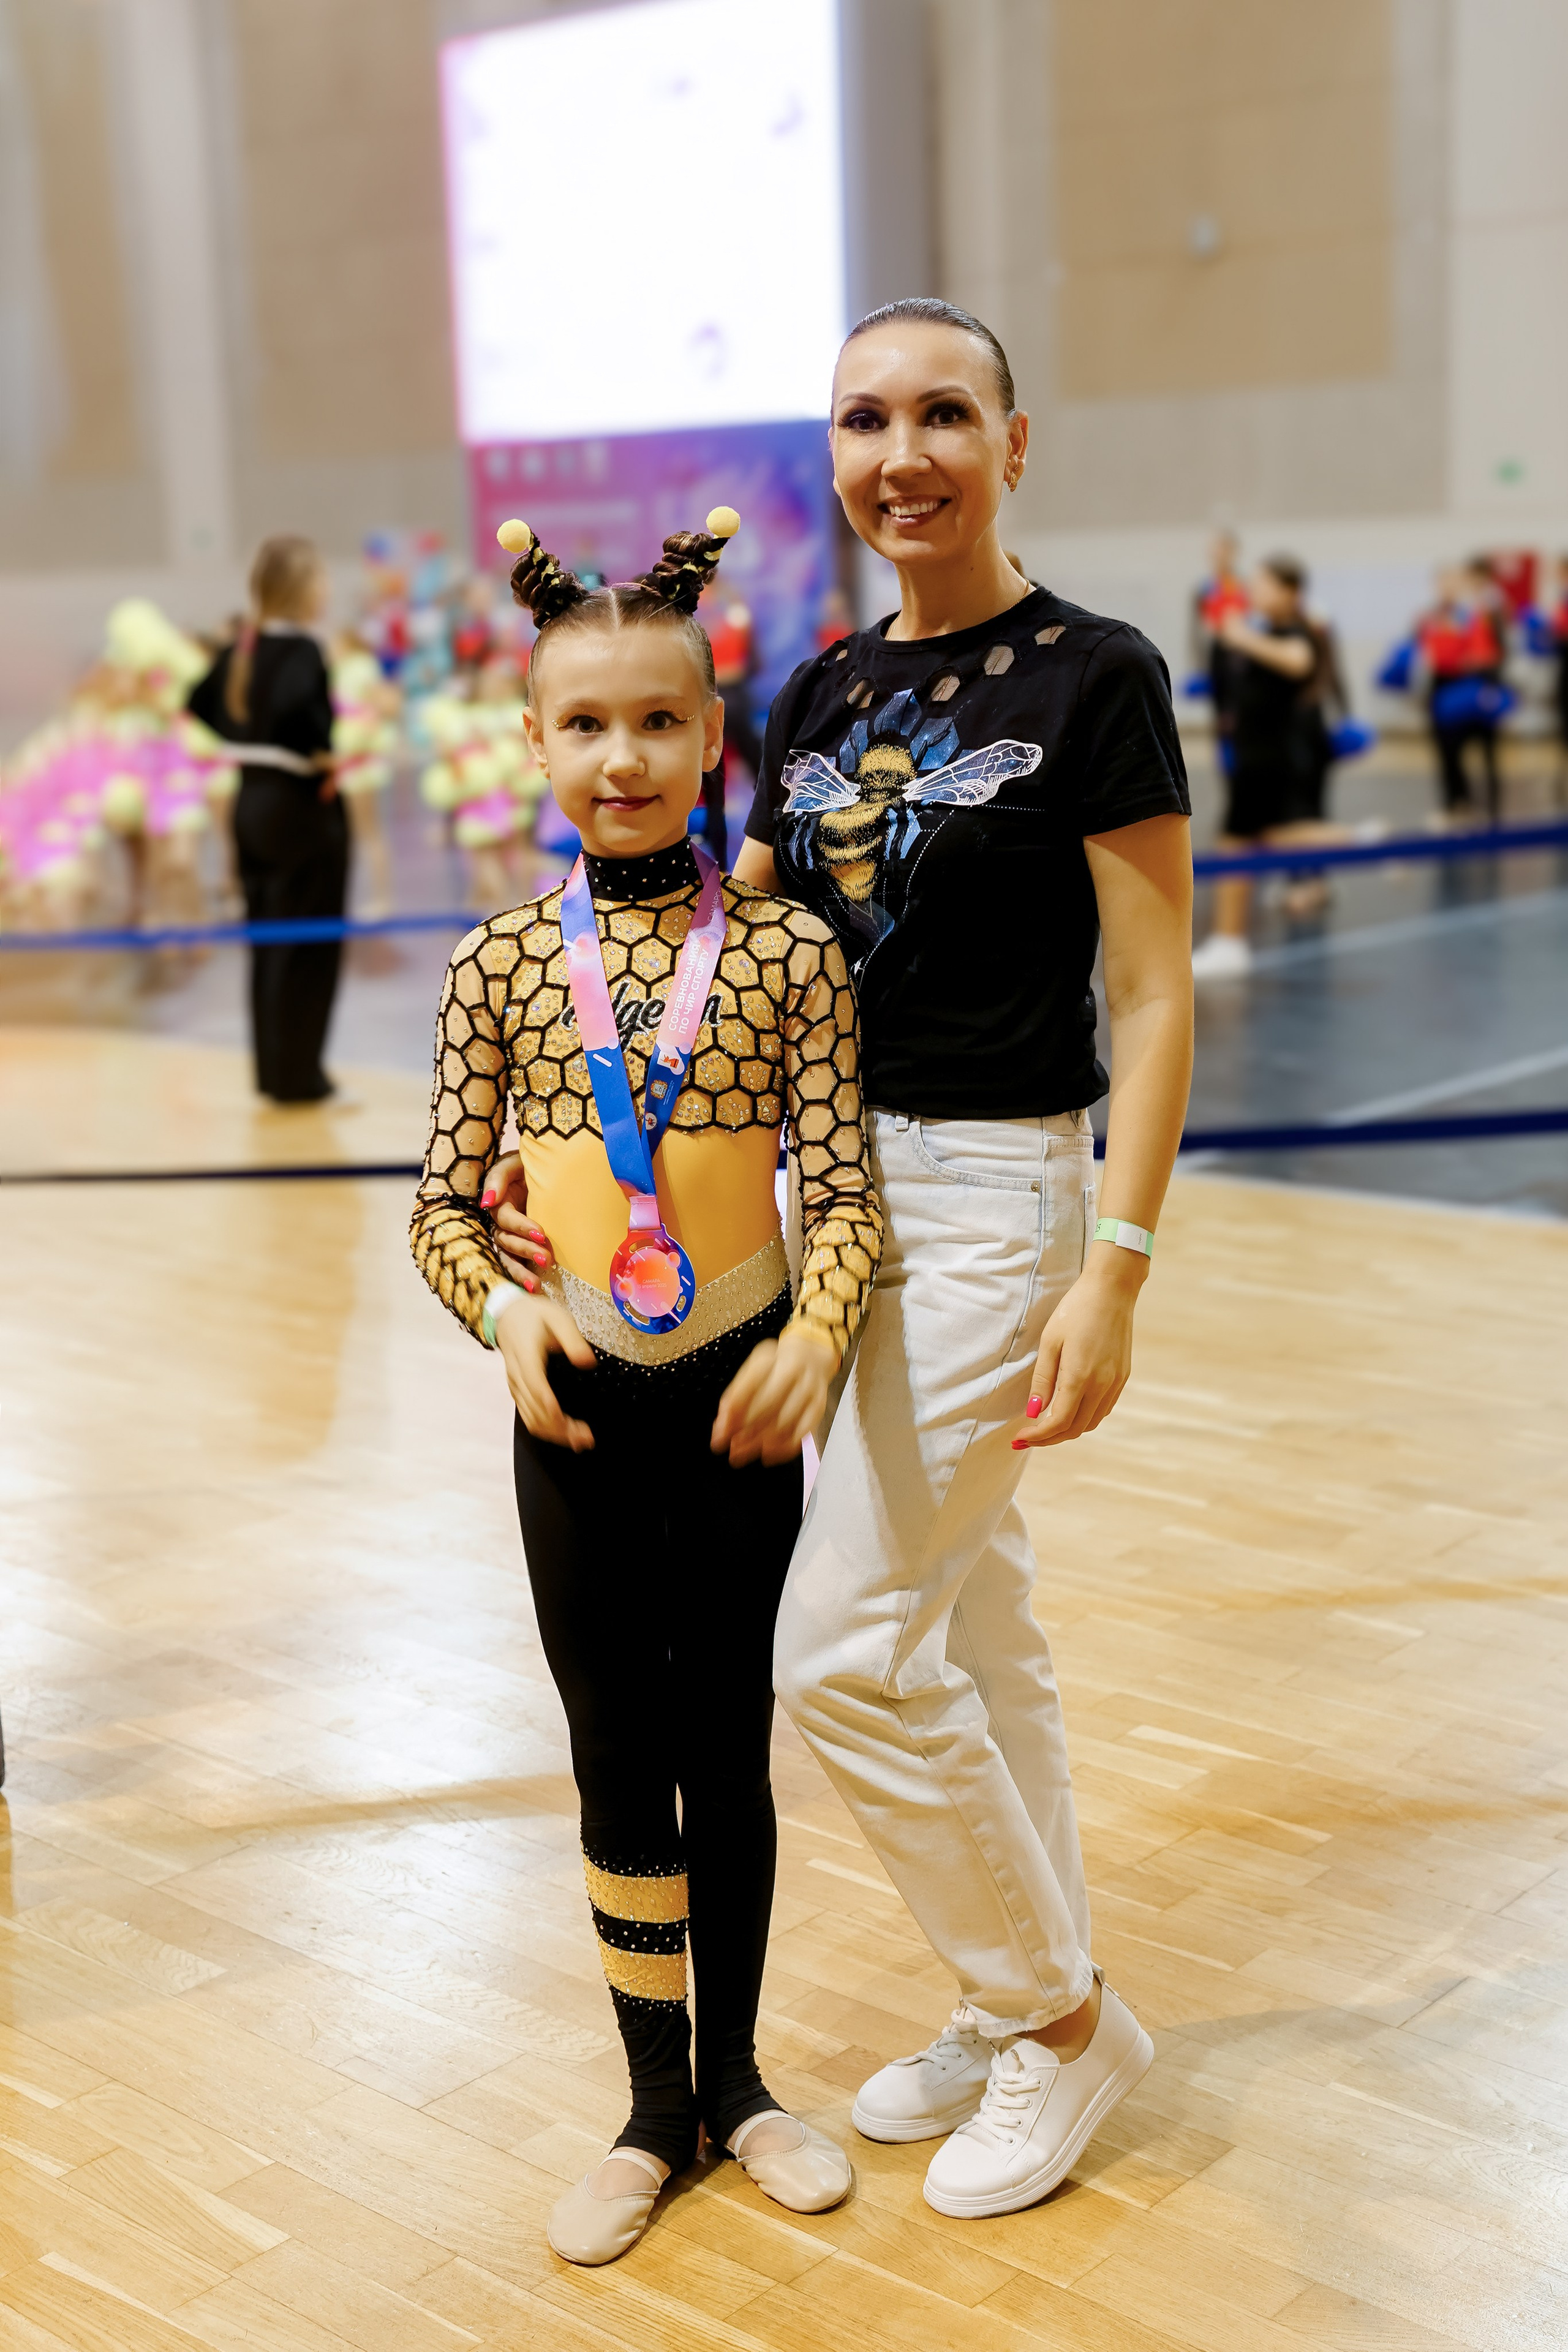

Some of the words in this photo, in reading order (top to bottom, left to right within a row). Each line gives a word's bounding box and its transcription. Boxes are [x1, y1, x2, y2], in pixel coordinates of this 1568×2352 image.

[707, 888, 722, 921] САМАРС
[668, 943, 701, 1031] СОРЕВНОВАНИЯ
[678, 1017, 690, 1035] ПО
[684, 992, 696, 1015] ЧИР
[692, 948, 709, 990] СПОРТУ
